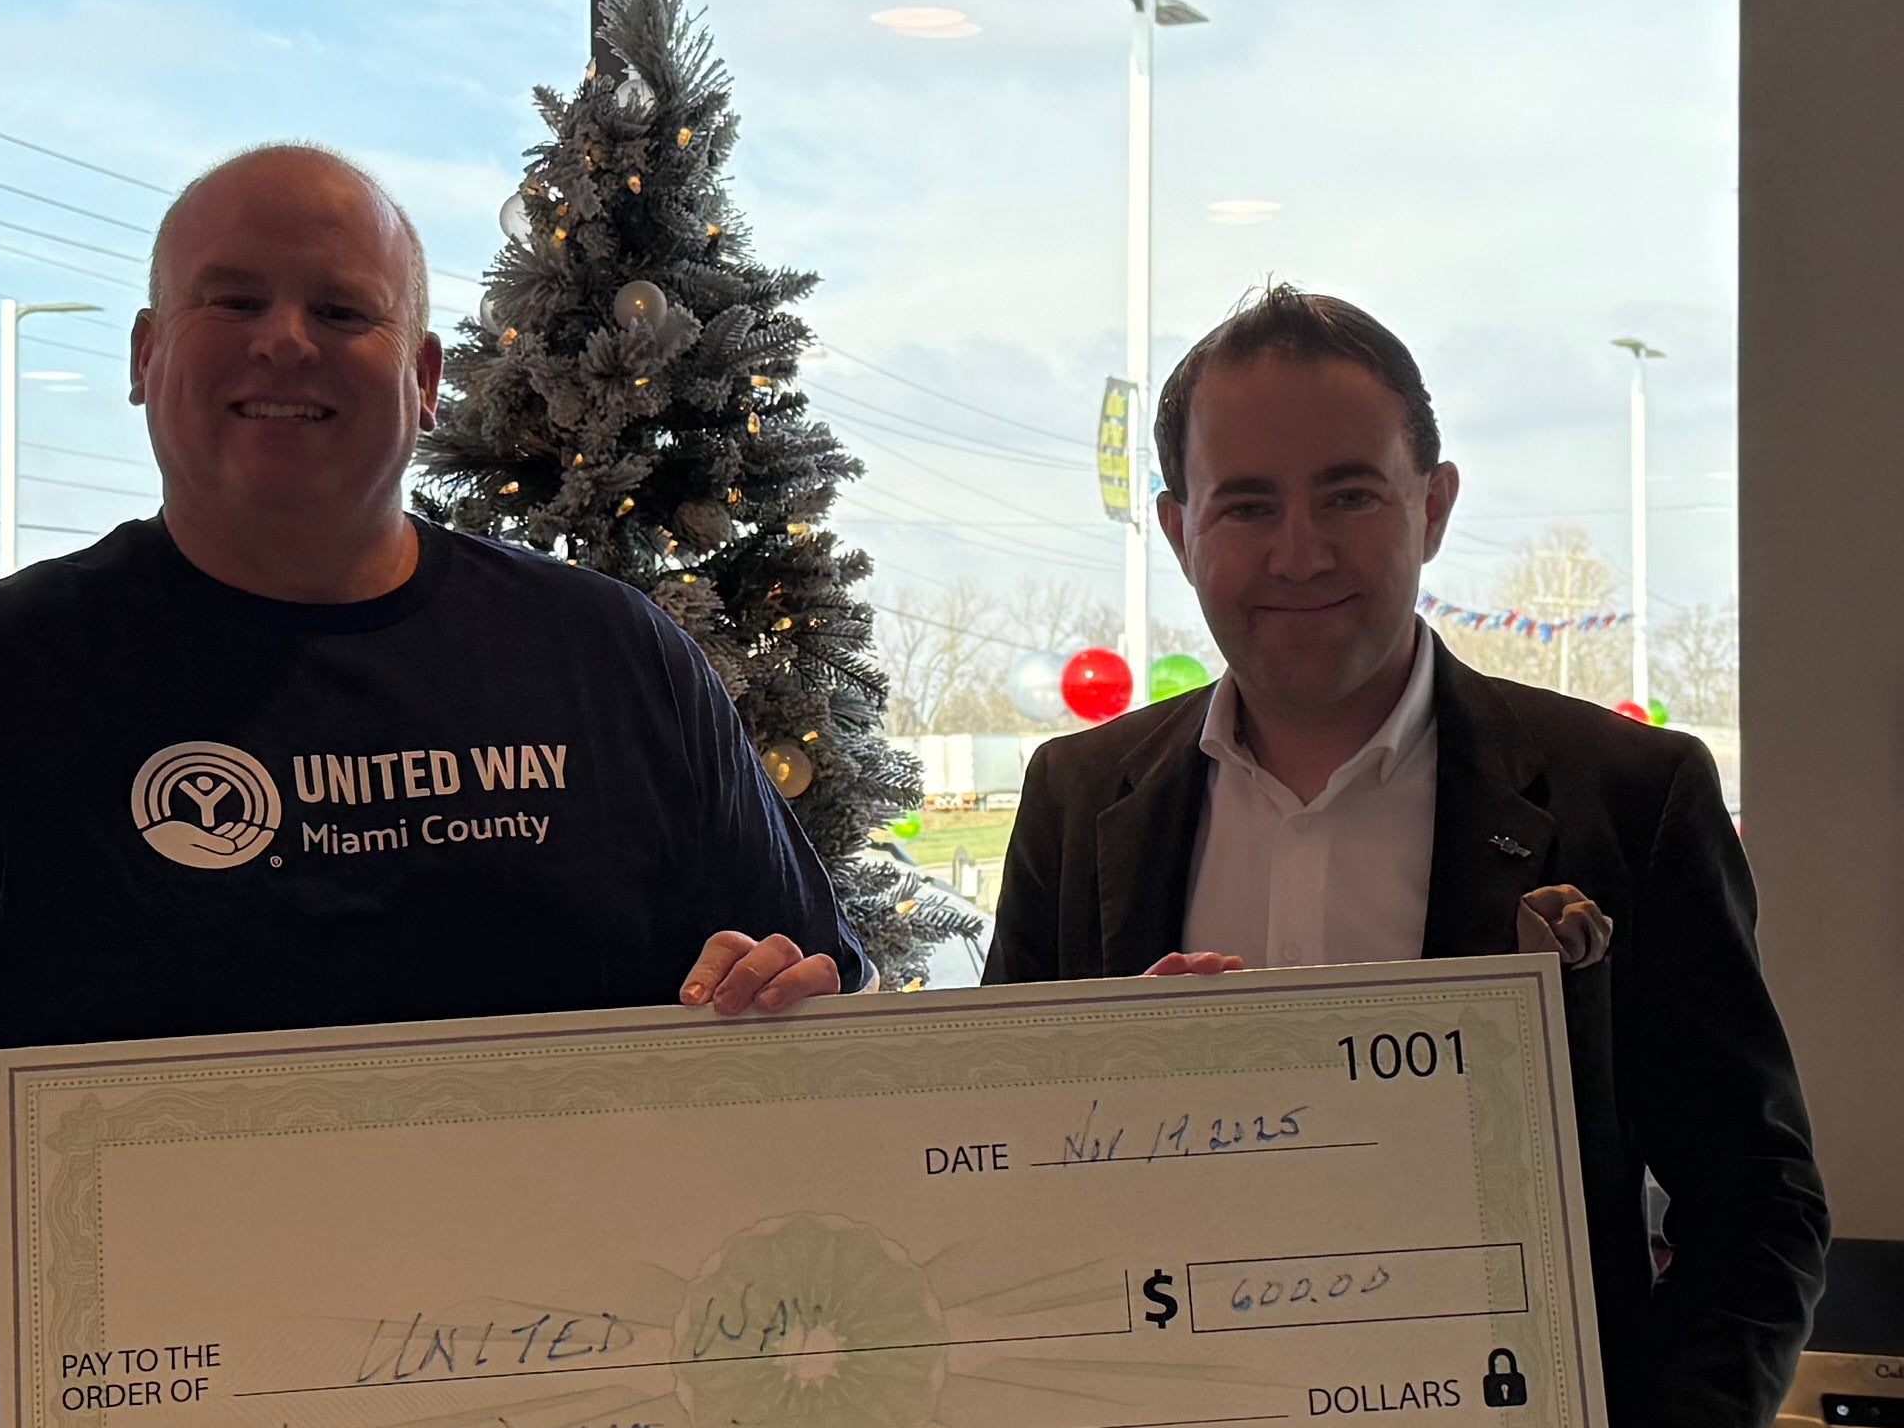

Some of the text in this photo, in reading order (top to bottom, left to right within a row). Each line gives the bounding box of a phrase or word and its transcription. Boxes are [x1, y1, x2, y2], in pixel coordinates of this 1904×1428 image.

[293, 745, 567, 805] UNITED WAY
[302, 810, 550, 855] Miami County
[1337, 1029, 1467, 1081] 1001
[924, 1143, 1009, 1176] DATE
[1142, 1268, 1178, 1330] $
[1229, 1268, 1391, 1313] 600.00
[357, 1293, 823, 1383] UNITED WAY
[62, 1343, 221, 1379] PAY TO THE
[62, 1378, 209, 1411] ORDER OF
[1307, 1378, 1463, 1417] DOLLARS
